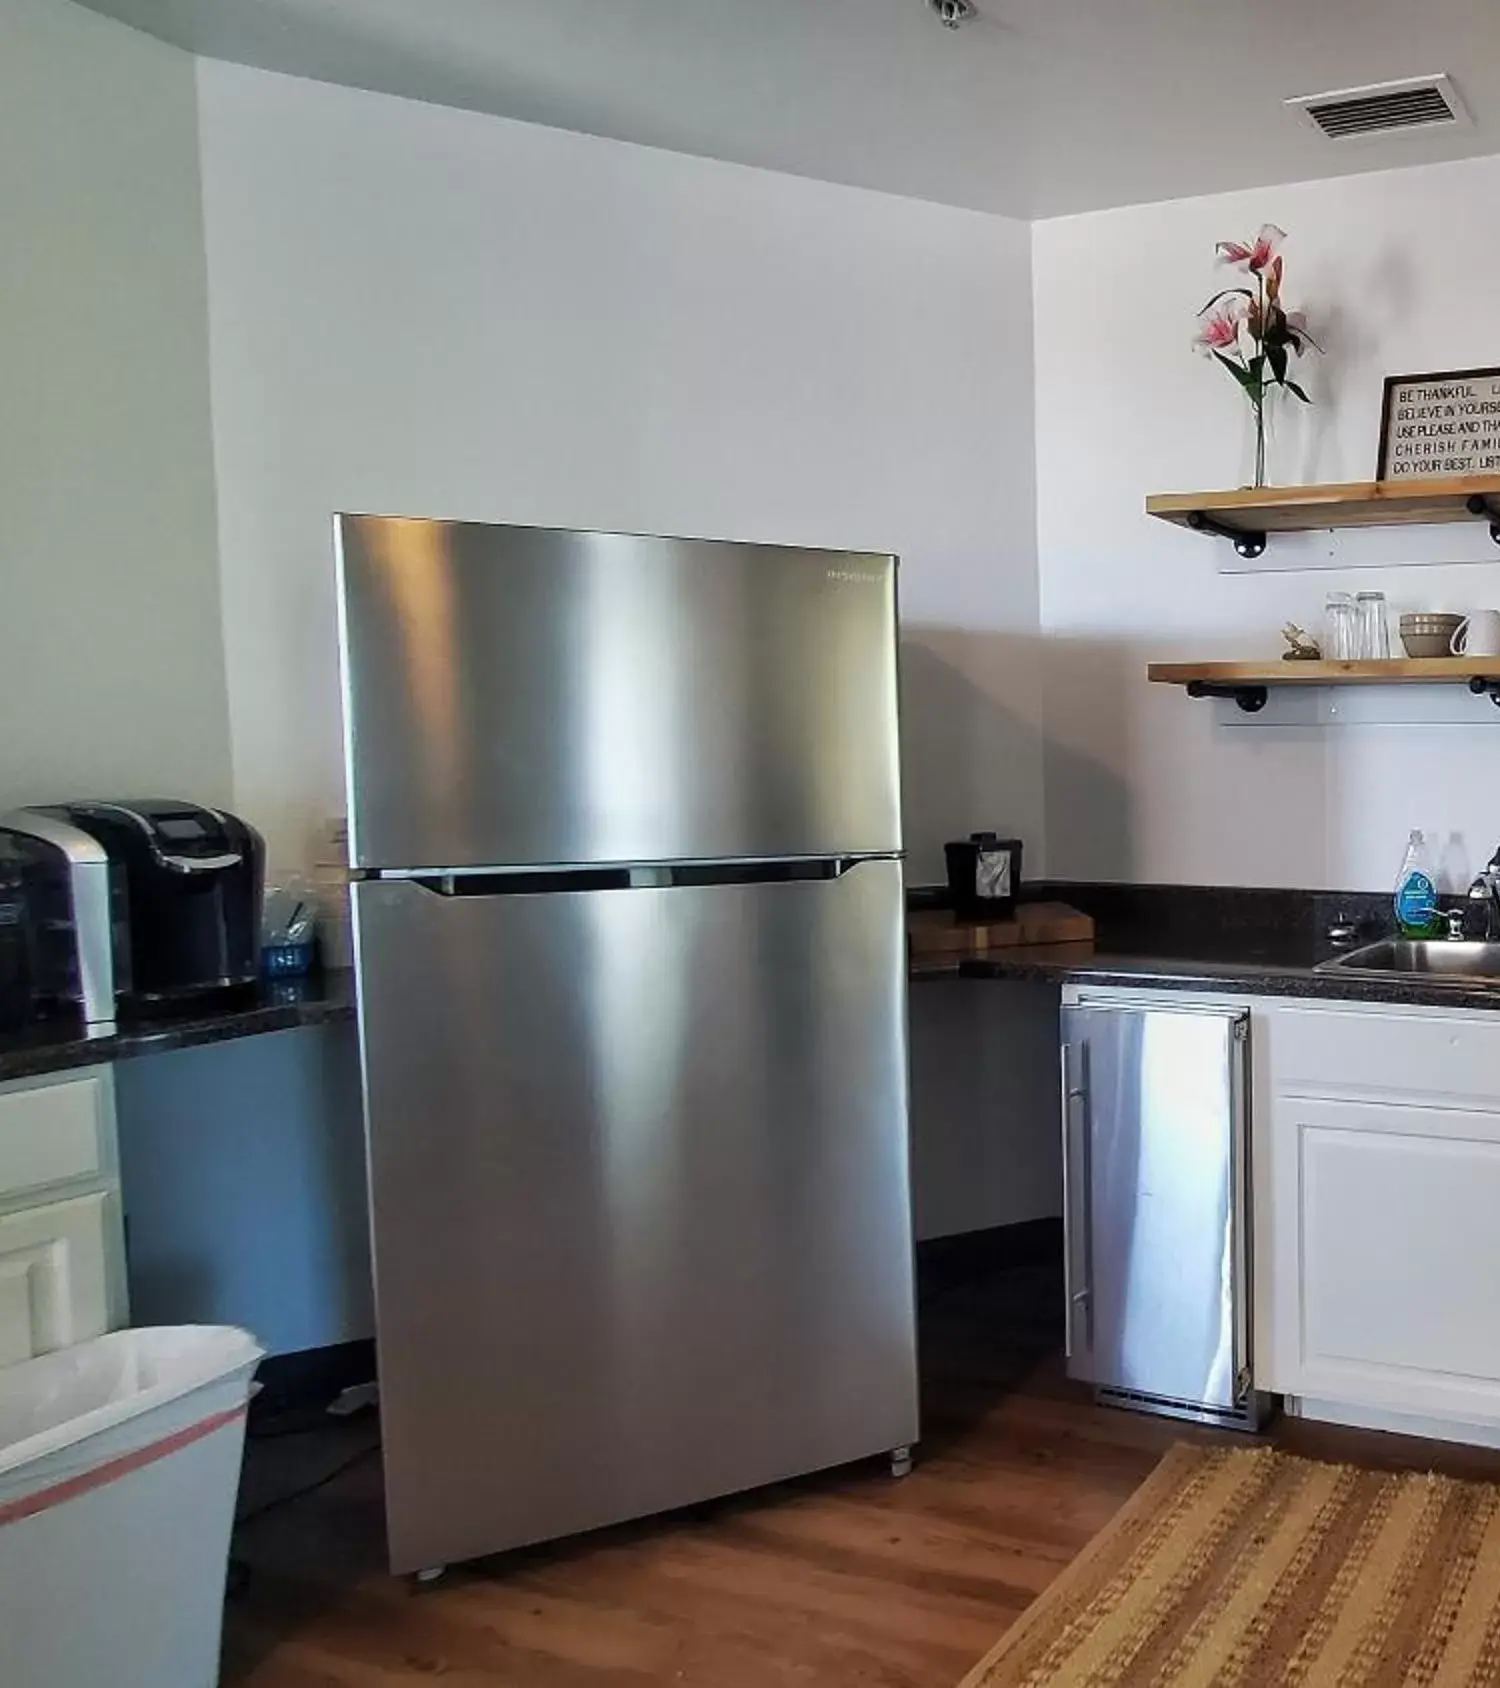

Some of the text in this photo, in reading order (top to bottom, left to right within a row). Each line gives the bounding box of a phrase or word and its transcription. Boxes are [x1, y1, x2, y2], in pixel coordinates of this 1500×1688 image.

[1400, 389, 1415, 403] BE
[1398, 405, 1443, 420] BELIEVE
[1444, 404, 1455, 417] IN
[1397, 425, 1417, 439] USE
[1418, 422, 1457, 437] PLEASE
[1458, 421, 1480, 435] AND
[1395, 441, 1456, 457] CHERISH
[1393, 461, 1410, 475] DO
[1411, 459, 1441, 473] YOUR
